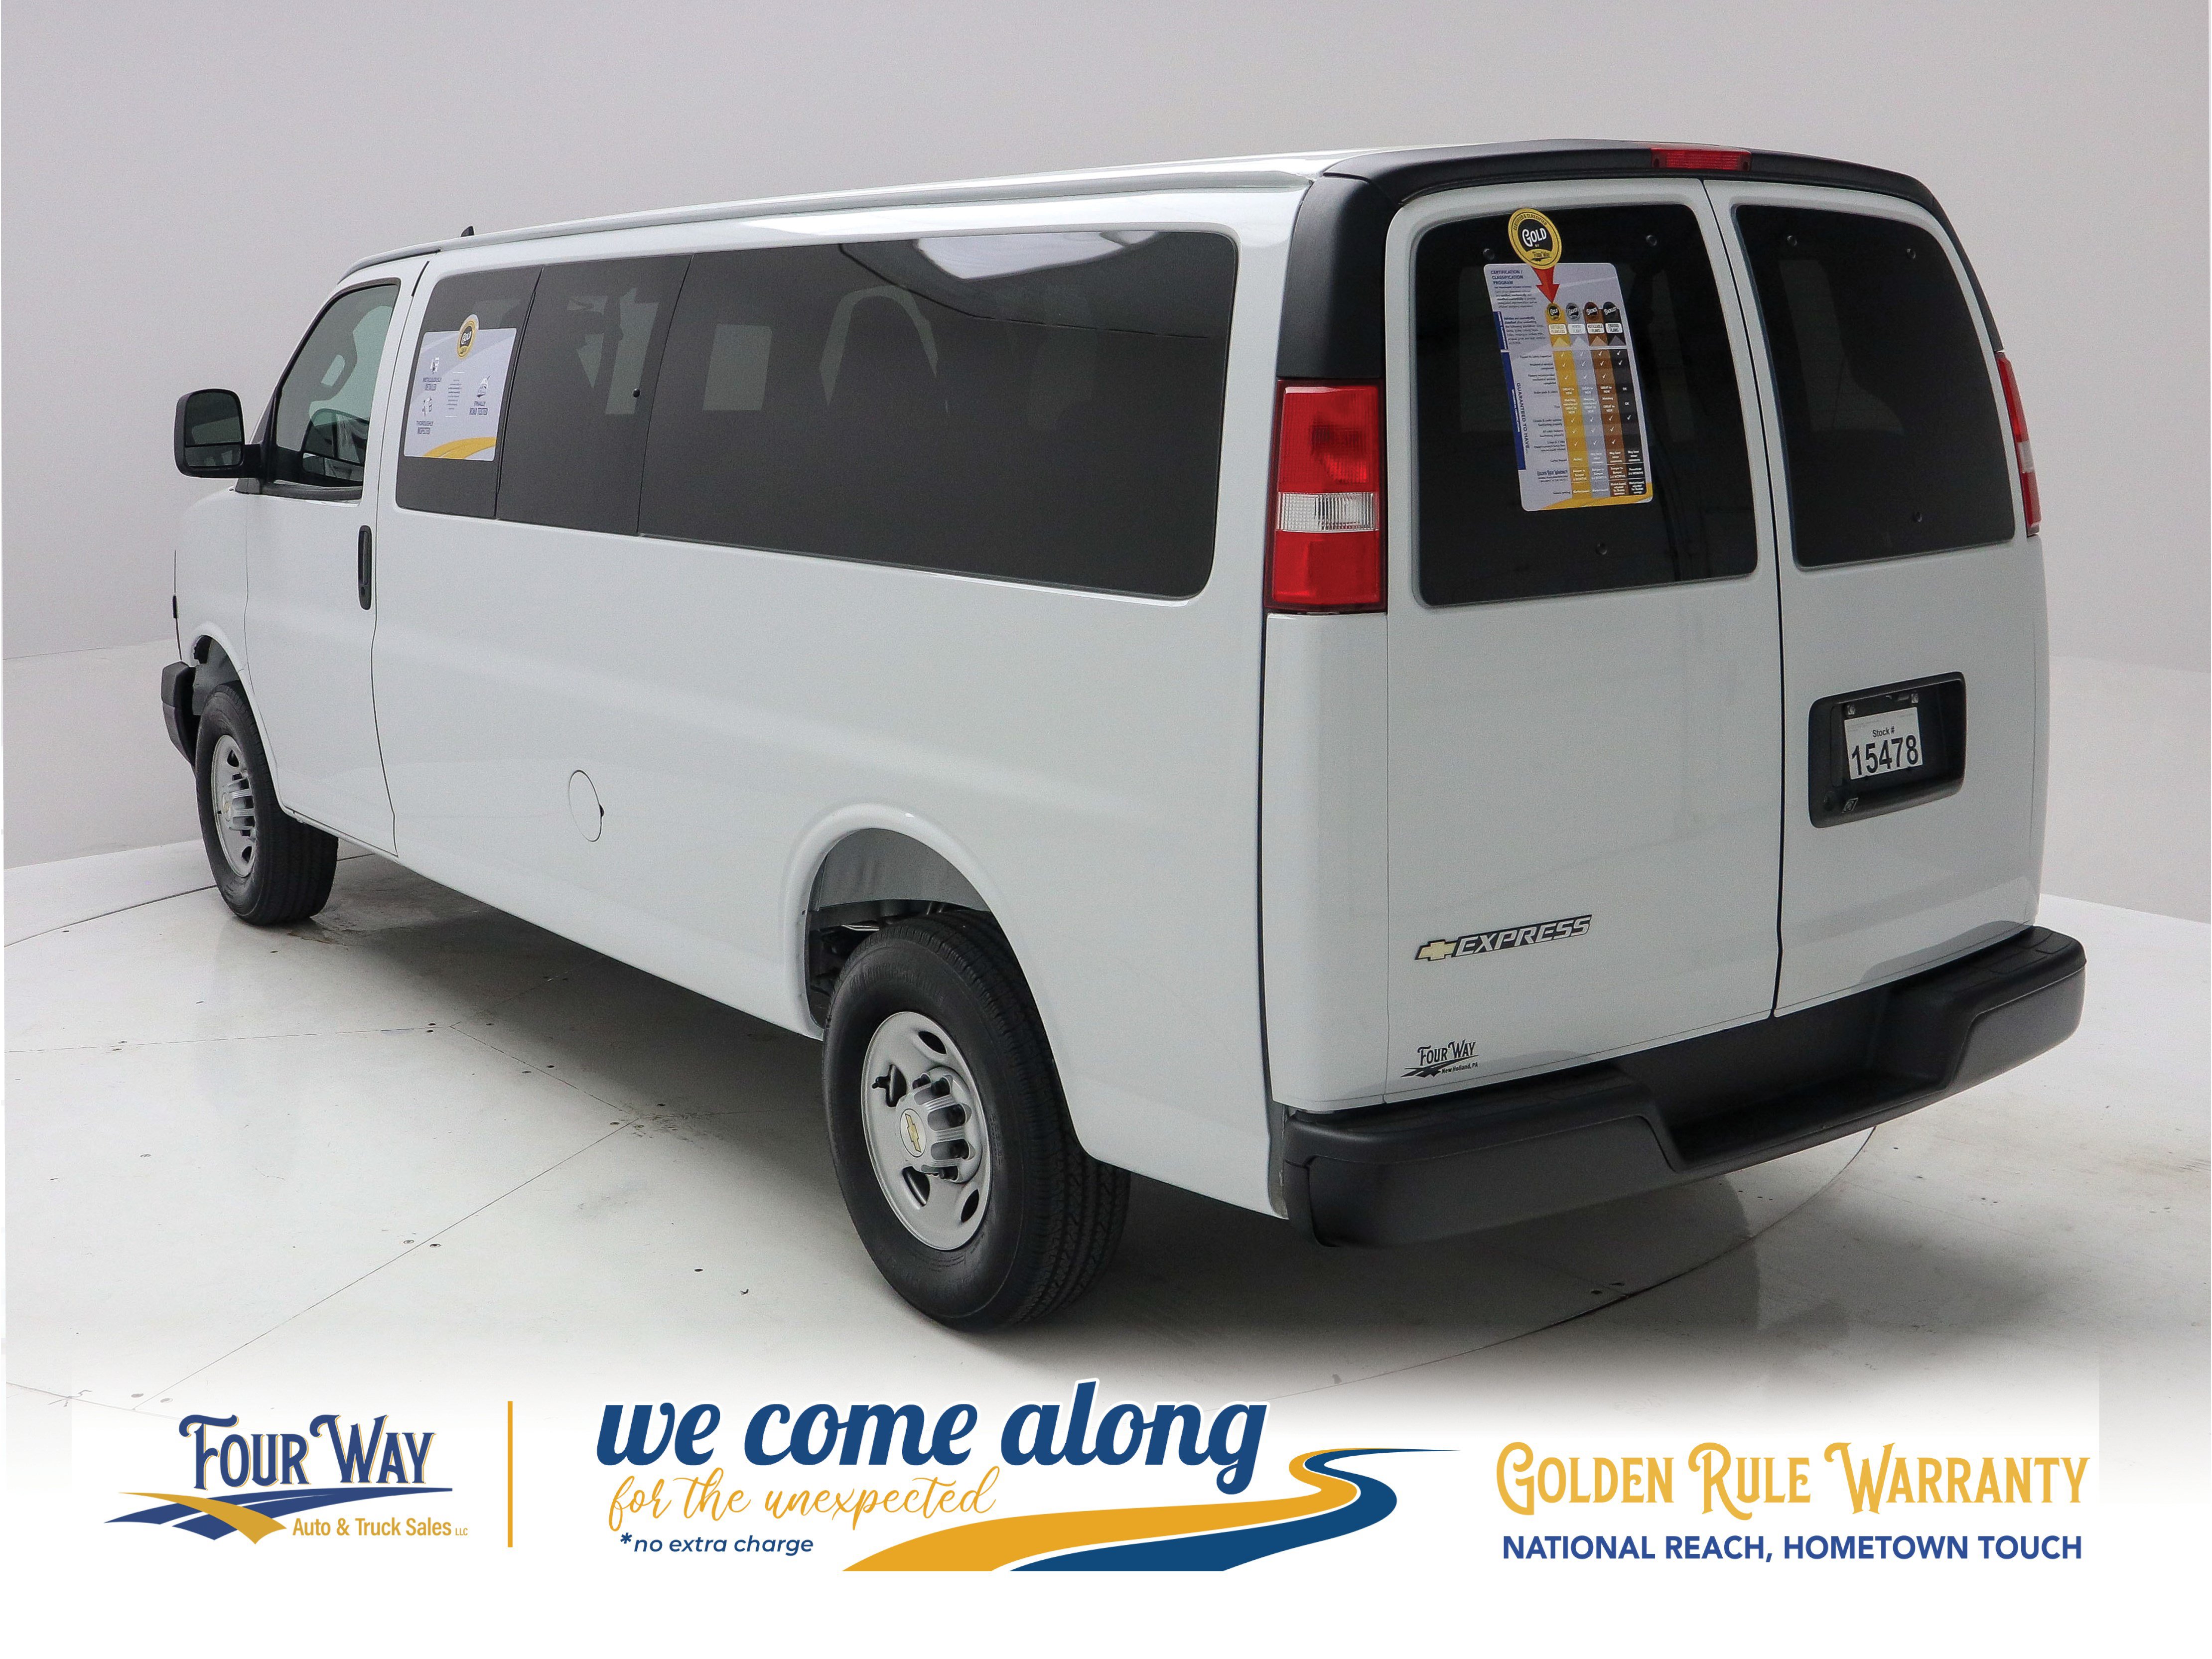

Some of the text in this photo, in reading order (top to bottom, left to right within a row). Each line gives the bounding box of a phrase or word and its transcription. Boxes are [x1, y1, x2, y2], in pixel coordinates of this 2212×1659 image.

[1522, 228, 1547, 247] GOLD
[1517, 382, 1526, 422] GUARANTEED
[1522, 423, 1527, 431] TO
[1872, 725, 1895, 738] Stock #
[1851, 734, 1919, 776] 15478
[1454, 916, 1592, 957] EXPRESS
[1417, 1039, 1477, 1066] FOUR WAY
[1452, 1063, 1472, 1072] Holland,
